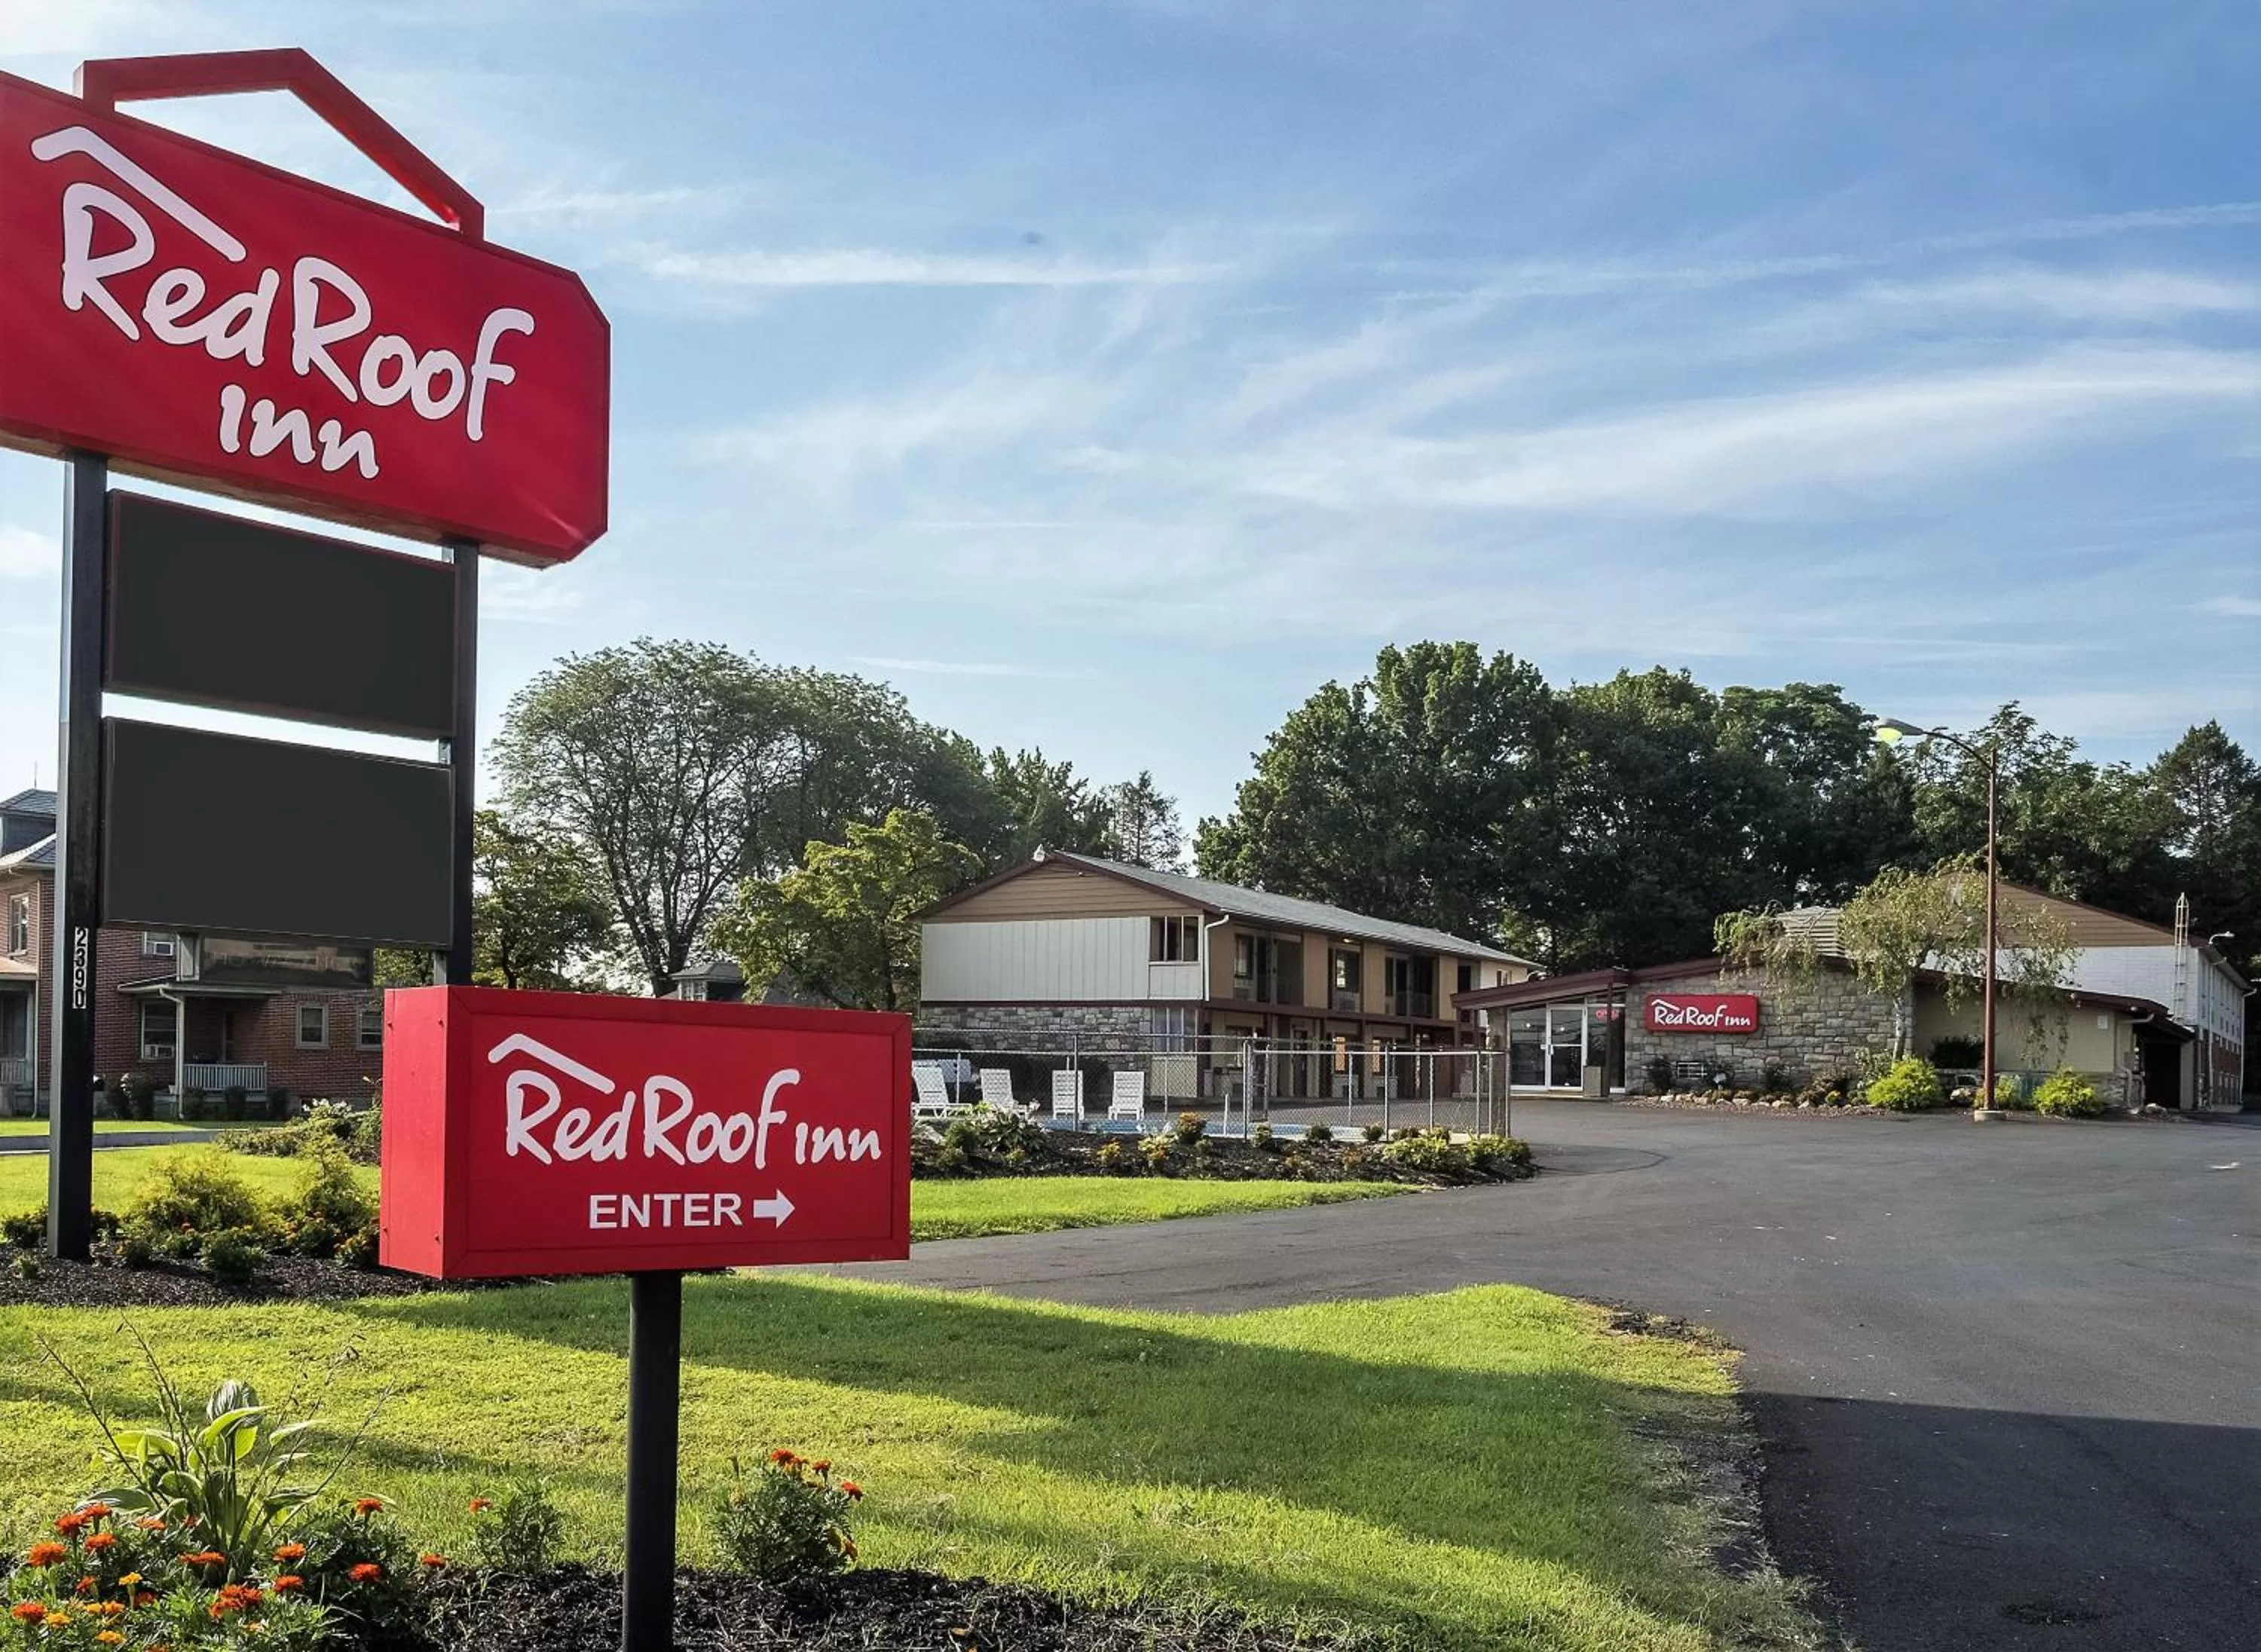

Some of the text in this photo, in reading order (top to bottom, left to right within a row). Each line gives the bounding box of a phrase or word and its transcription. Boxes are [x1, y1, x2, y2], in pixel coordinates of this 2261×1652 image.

[62, 182, 535, 442] Red Roof
[74, 927, 87, 1008] 2390
[1654, 1006, 1685, 1025] Red
[1686, 1005, 1727, 1027] Roof
[506, 1069, 637, 1164] Red
[643, 1068, 800, 1170] Roof
[589, 1193, 742, 1229] ENTER
